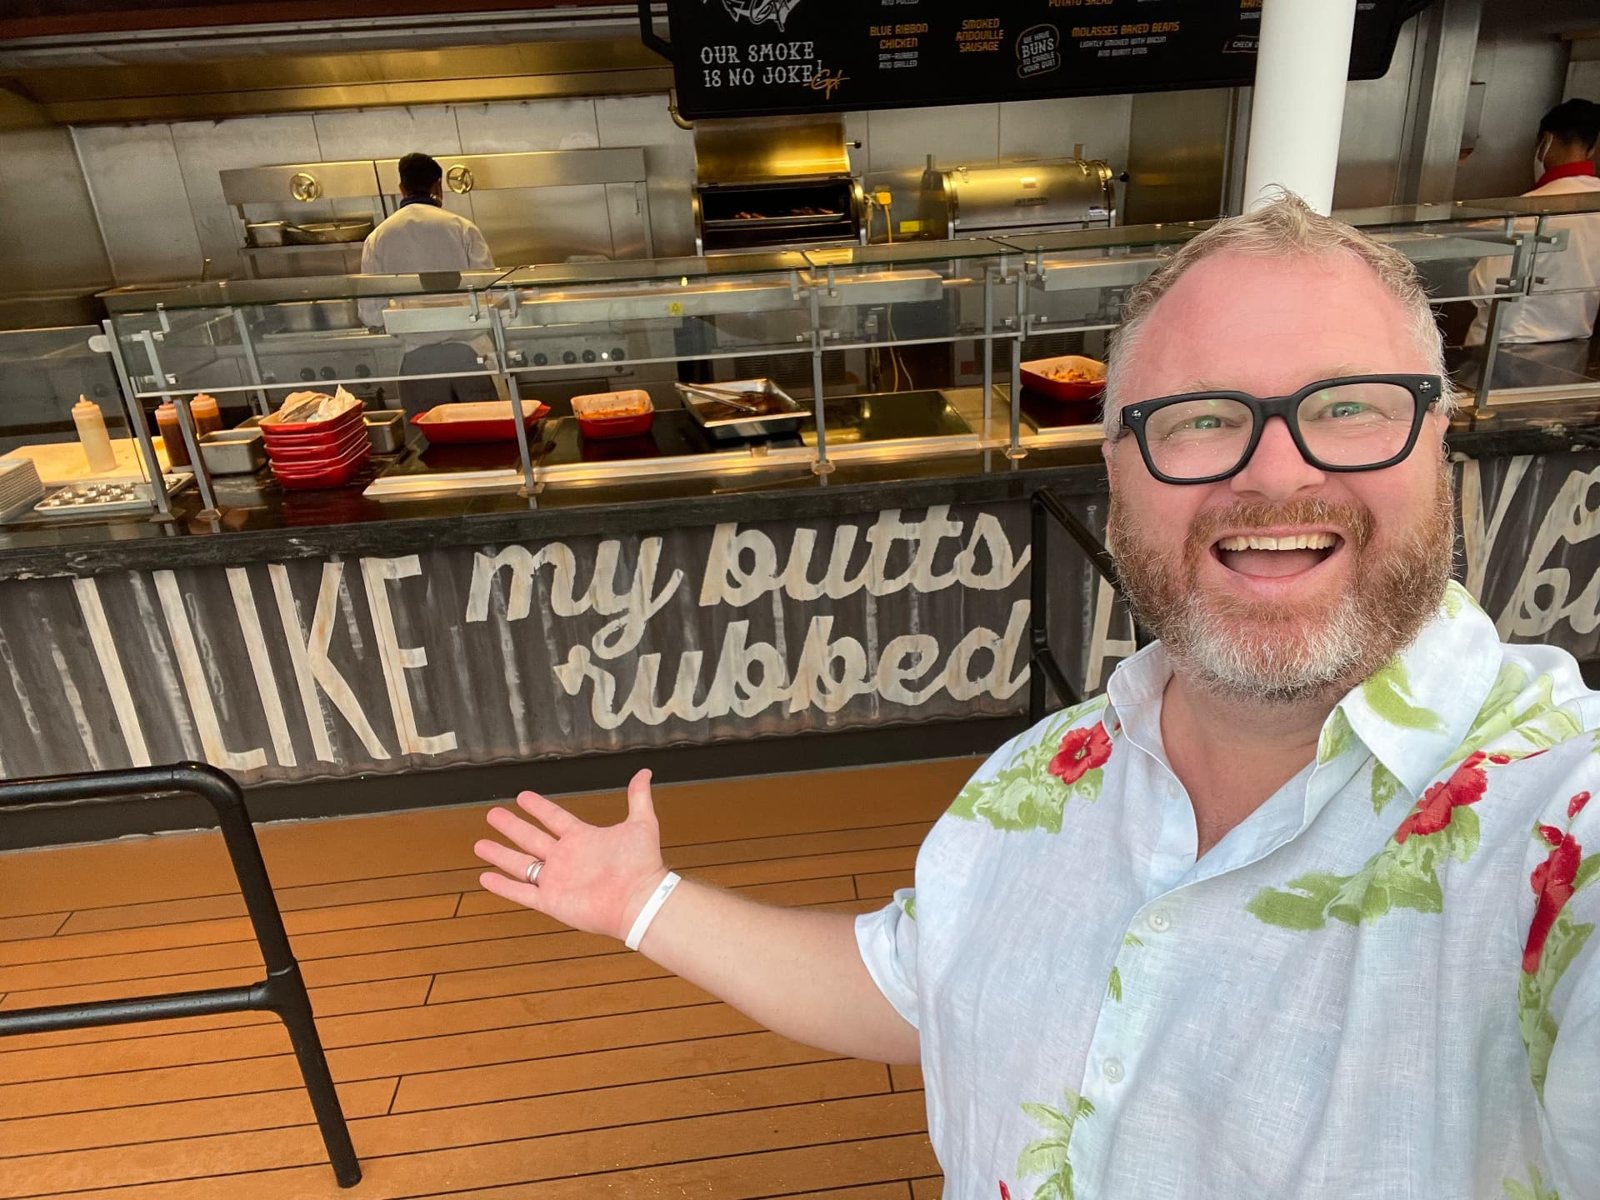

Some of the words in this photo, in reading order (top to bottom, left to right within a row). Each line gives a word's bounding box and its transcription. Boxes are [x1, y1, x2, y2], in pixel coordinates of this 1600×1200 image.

[869, 24, 893, 37] BLUE
[895, 22, 929, 35] RIBBON
[961, 17, 1001, 30] SMOKED
[1071, 25, 1119, 37] MOLASSES
[1120, 23, 1150, 35] BAKED
[1151, 21, 1181, 32] BEANS
[954, 28, 1005, 42] ANDOUILLE
[879, 37, 919, 50] CHICKEN
[959, 40, 1000, 53] SAUSAGE
[1021, 37, 1055, 58] BUNS
[700, 45, 741, 65] OUR
[747, 41, 815, 63] SMOKE
[703, 69, 722, 88] IS
[728, 68, 756, 87] NO
[73, 577, 152, 768] I
[152, 554, 458, 771] LIKE
[465, 536, 684, 660] my
[698, 504, 1032, 609] butts
[553, 598, 1032, 730] rubbed
